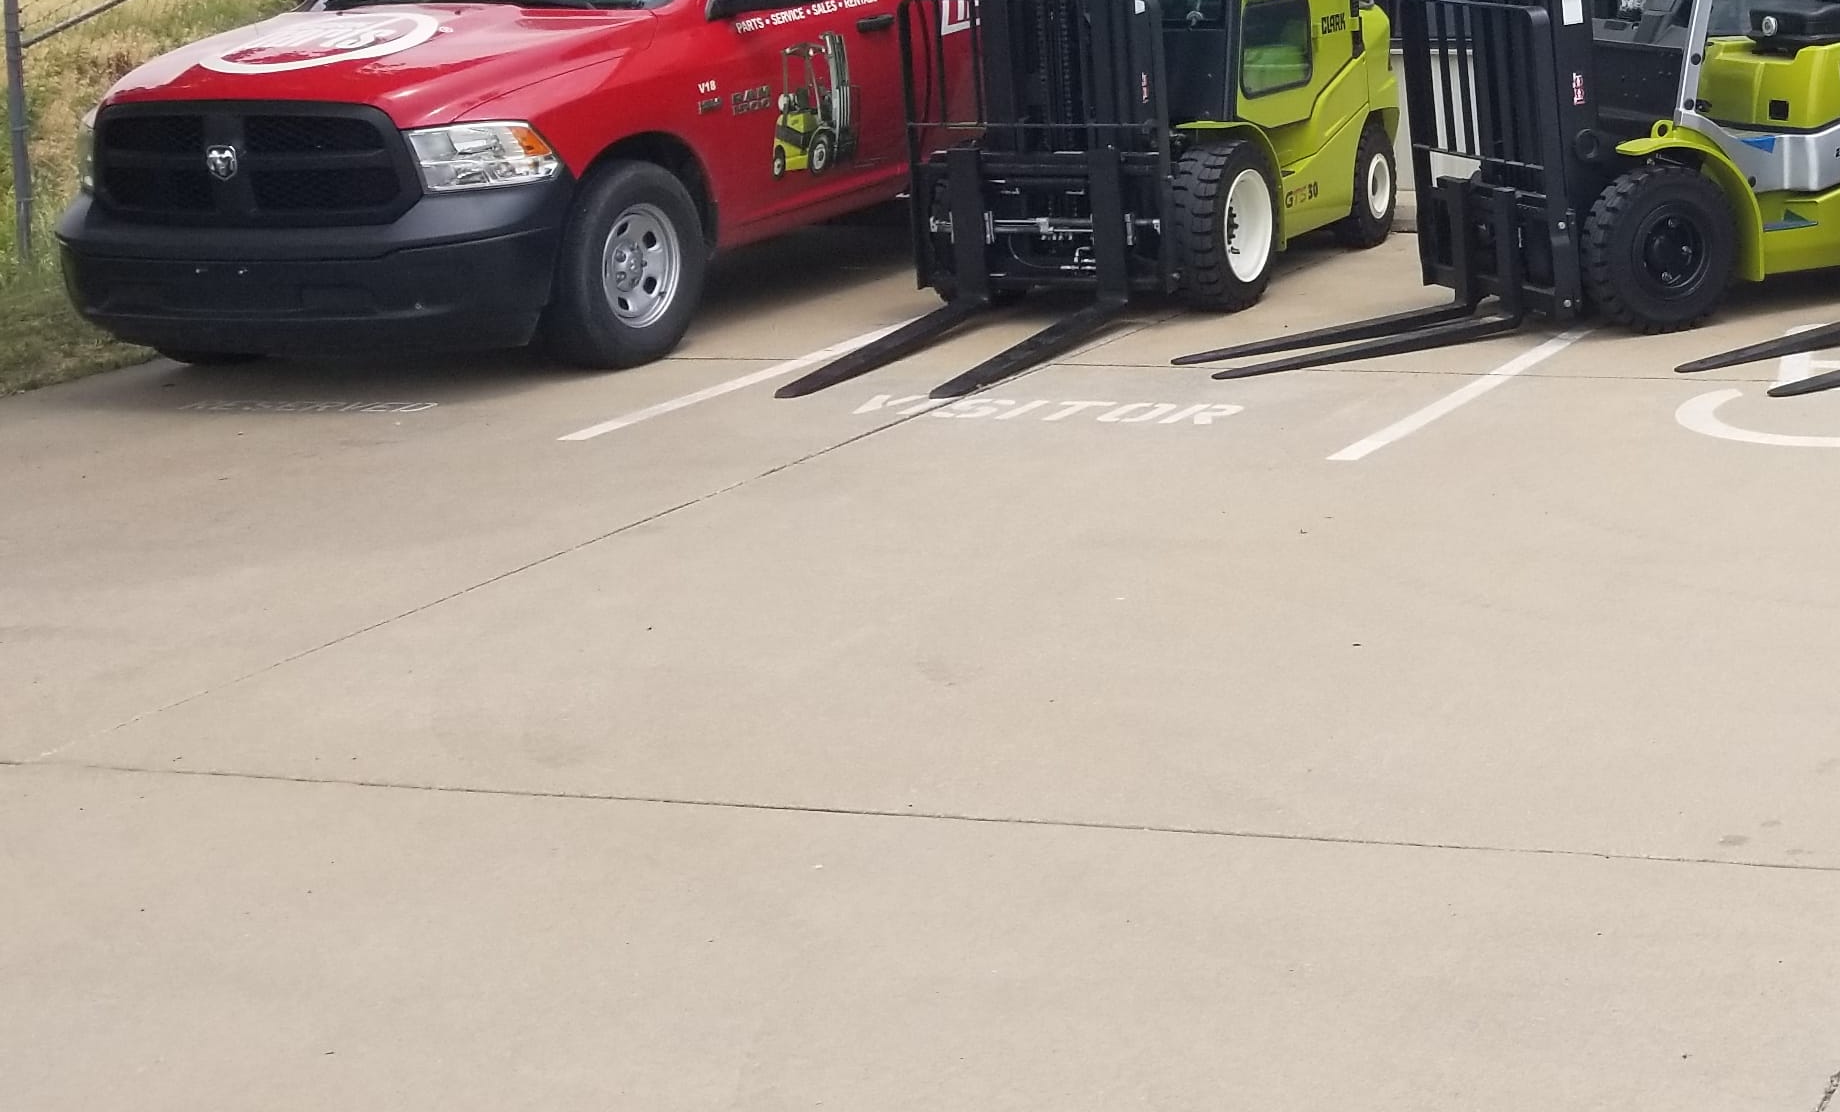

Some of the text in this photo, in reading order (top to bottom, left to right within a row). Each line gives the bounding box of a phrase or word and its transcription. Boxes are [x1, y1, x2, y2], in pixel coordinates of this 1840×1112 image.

[735, 17, 765, 34] PARTS
[770, 7, 805, 26] SERVICE
[811, 0, 838, 17] SALES
[1321, 12, 1346, 35] CLARK
[697, 79, 717, 94] V18
[1284, 181, 1319, 209] GTS 30
[851, 393, 1246, 426] VISITOR
